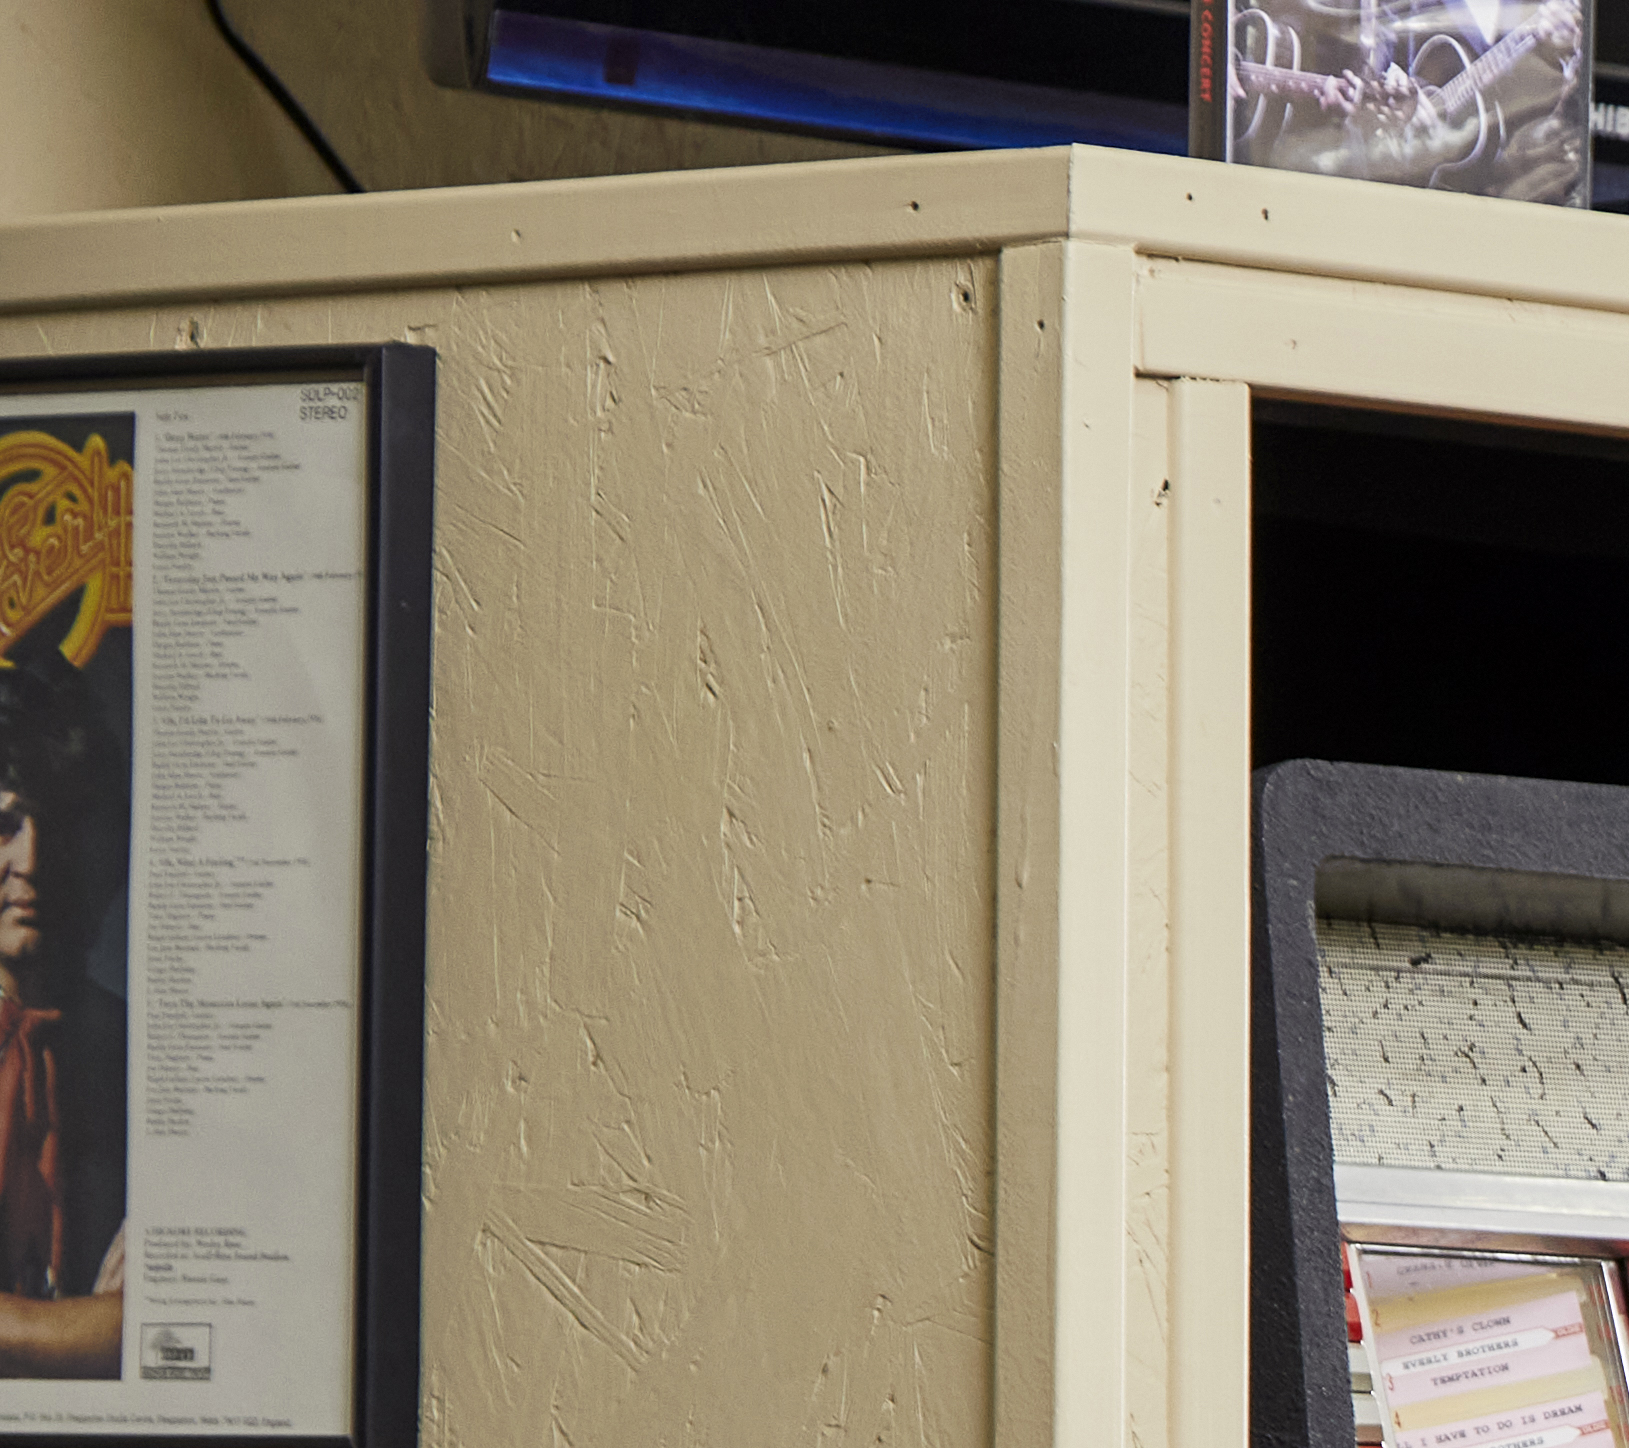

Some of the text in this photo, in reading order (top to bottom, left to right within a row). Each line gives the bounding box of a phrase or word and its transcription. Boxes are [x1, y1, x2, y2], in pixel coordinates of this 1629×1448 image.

[300, 405, 348, 420] STEREO
[1409, 1316, 1512, 1345] CATHY'S CLOWN
[1402, 1338, 1519, 1370] EVERLY BROTHERS
[1430, 1362, 1510, 1386] TEMPTATION
[1435, 1427, 1467, 1443] HAVE
[1473, 1422, 1490, 1435] TO
[1497, 1418, 1514, 1430] DO
[1520, 1413, 1537, 1425] IS
[1543, 1404, 1583, 1421] DREAM
